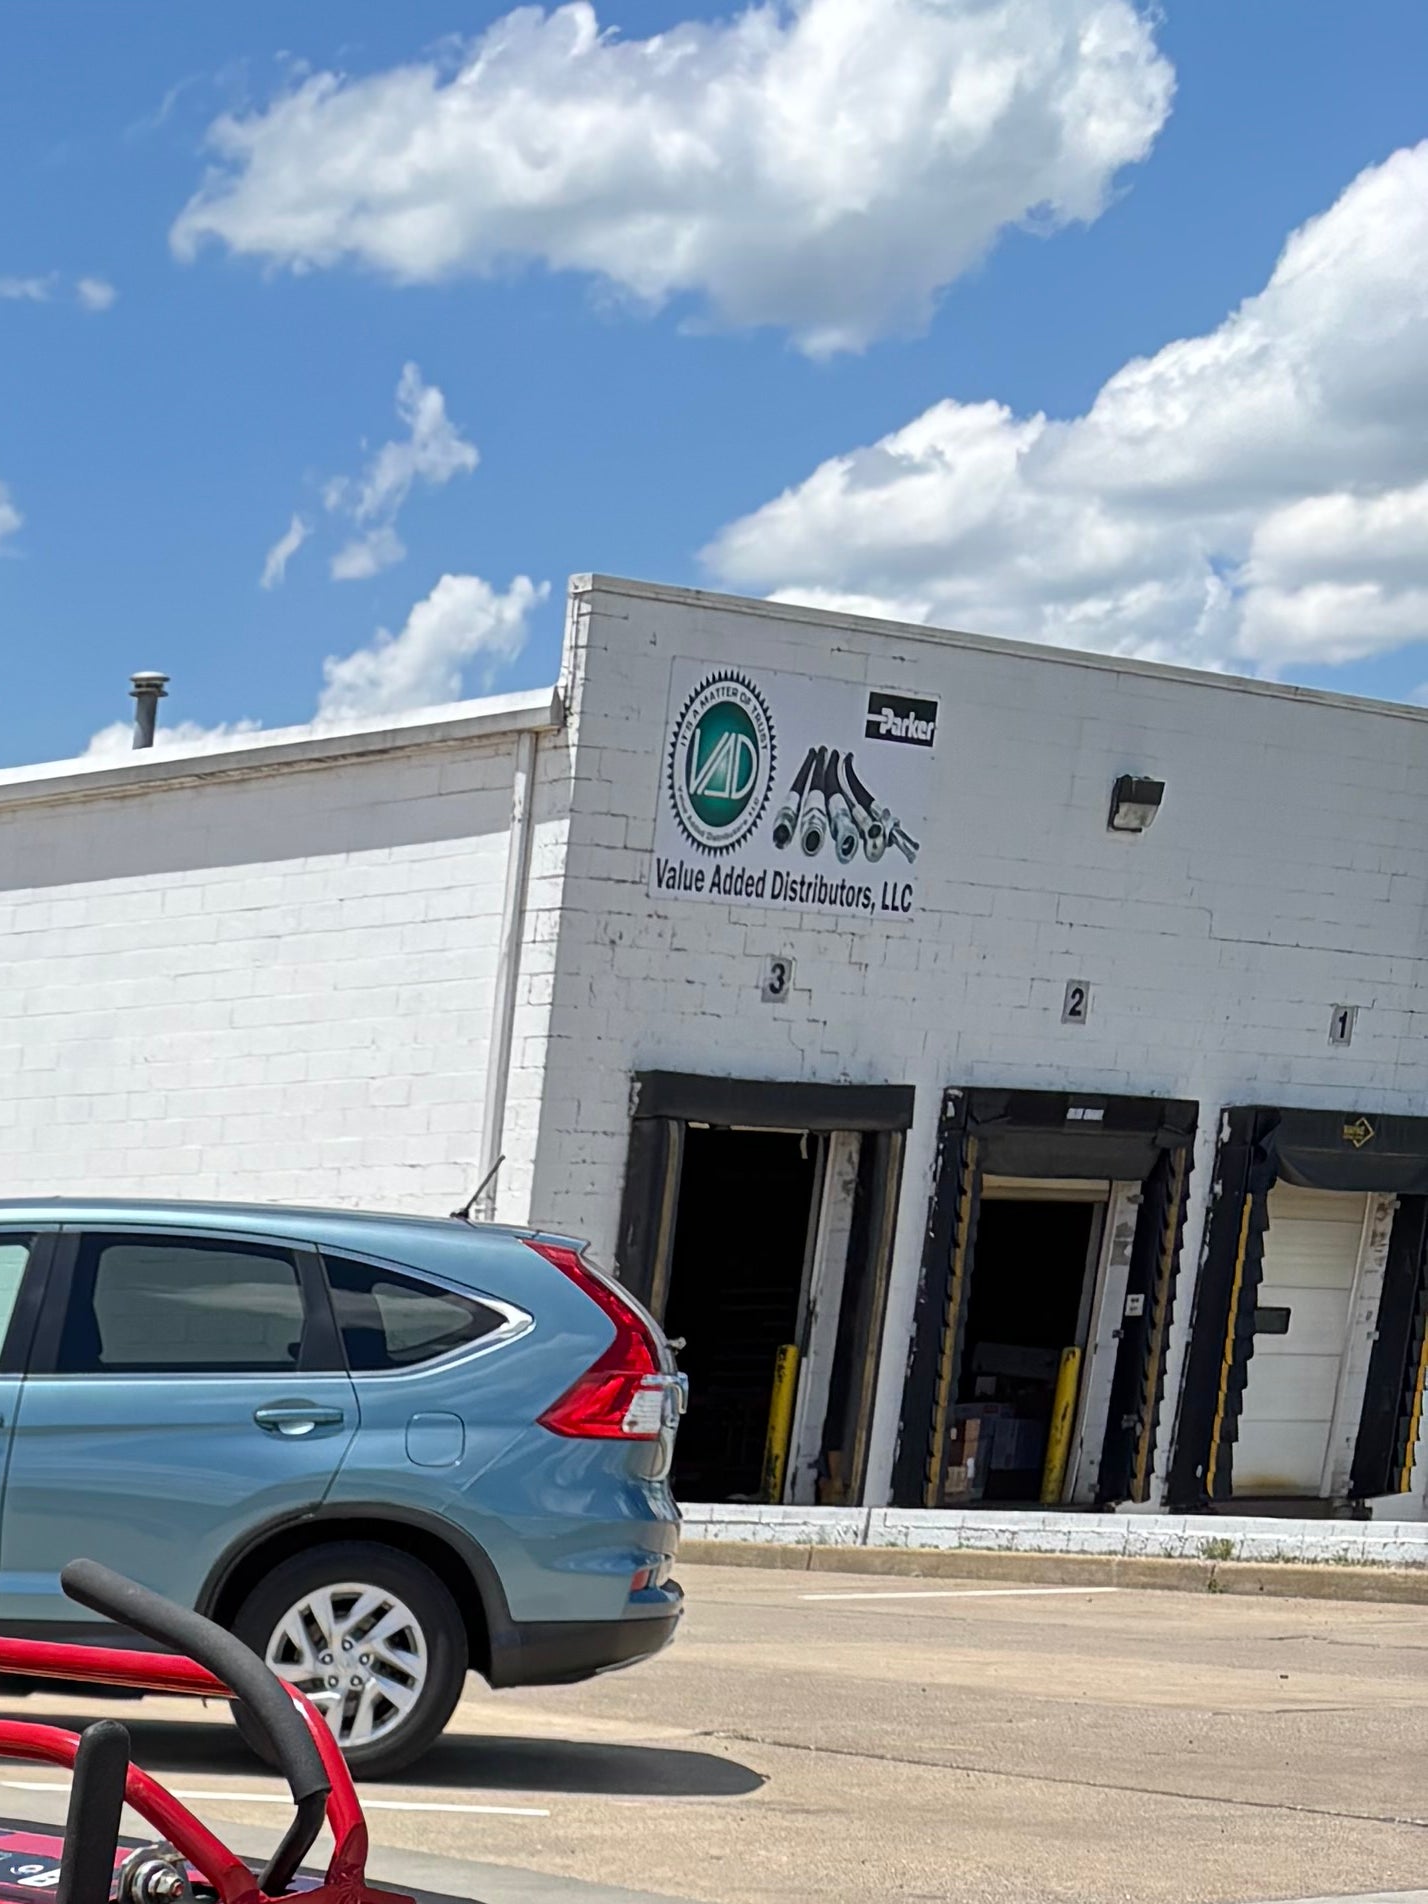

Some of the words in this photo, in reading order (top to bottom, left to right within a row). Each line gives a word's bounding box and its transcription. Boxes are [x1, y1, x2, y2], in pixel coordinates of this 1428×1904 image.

[879, 707, 935, 741] Parker
[655, 857, 705, 893] Value
[709, 864, 768, 900] Added
[770, 870, 876, 915] Distributors,
[880, 880, 914, 913] LLC
[768, 962, 786, 995] 3
[1068, 987, 1085, 1017] 2
[1338, 1010, 1348, 1039] 1
